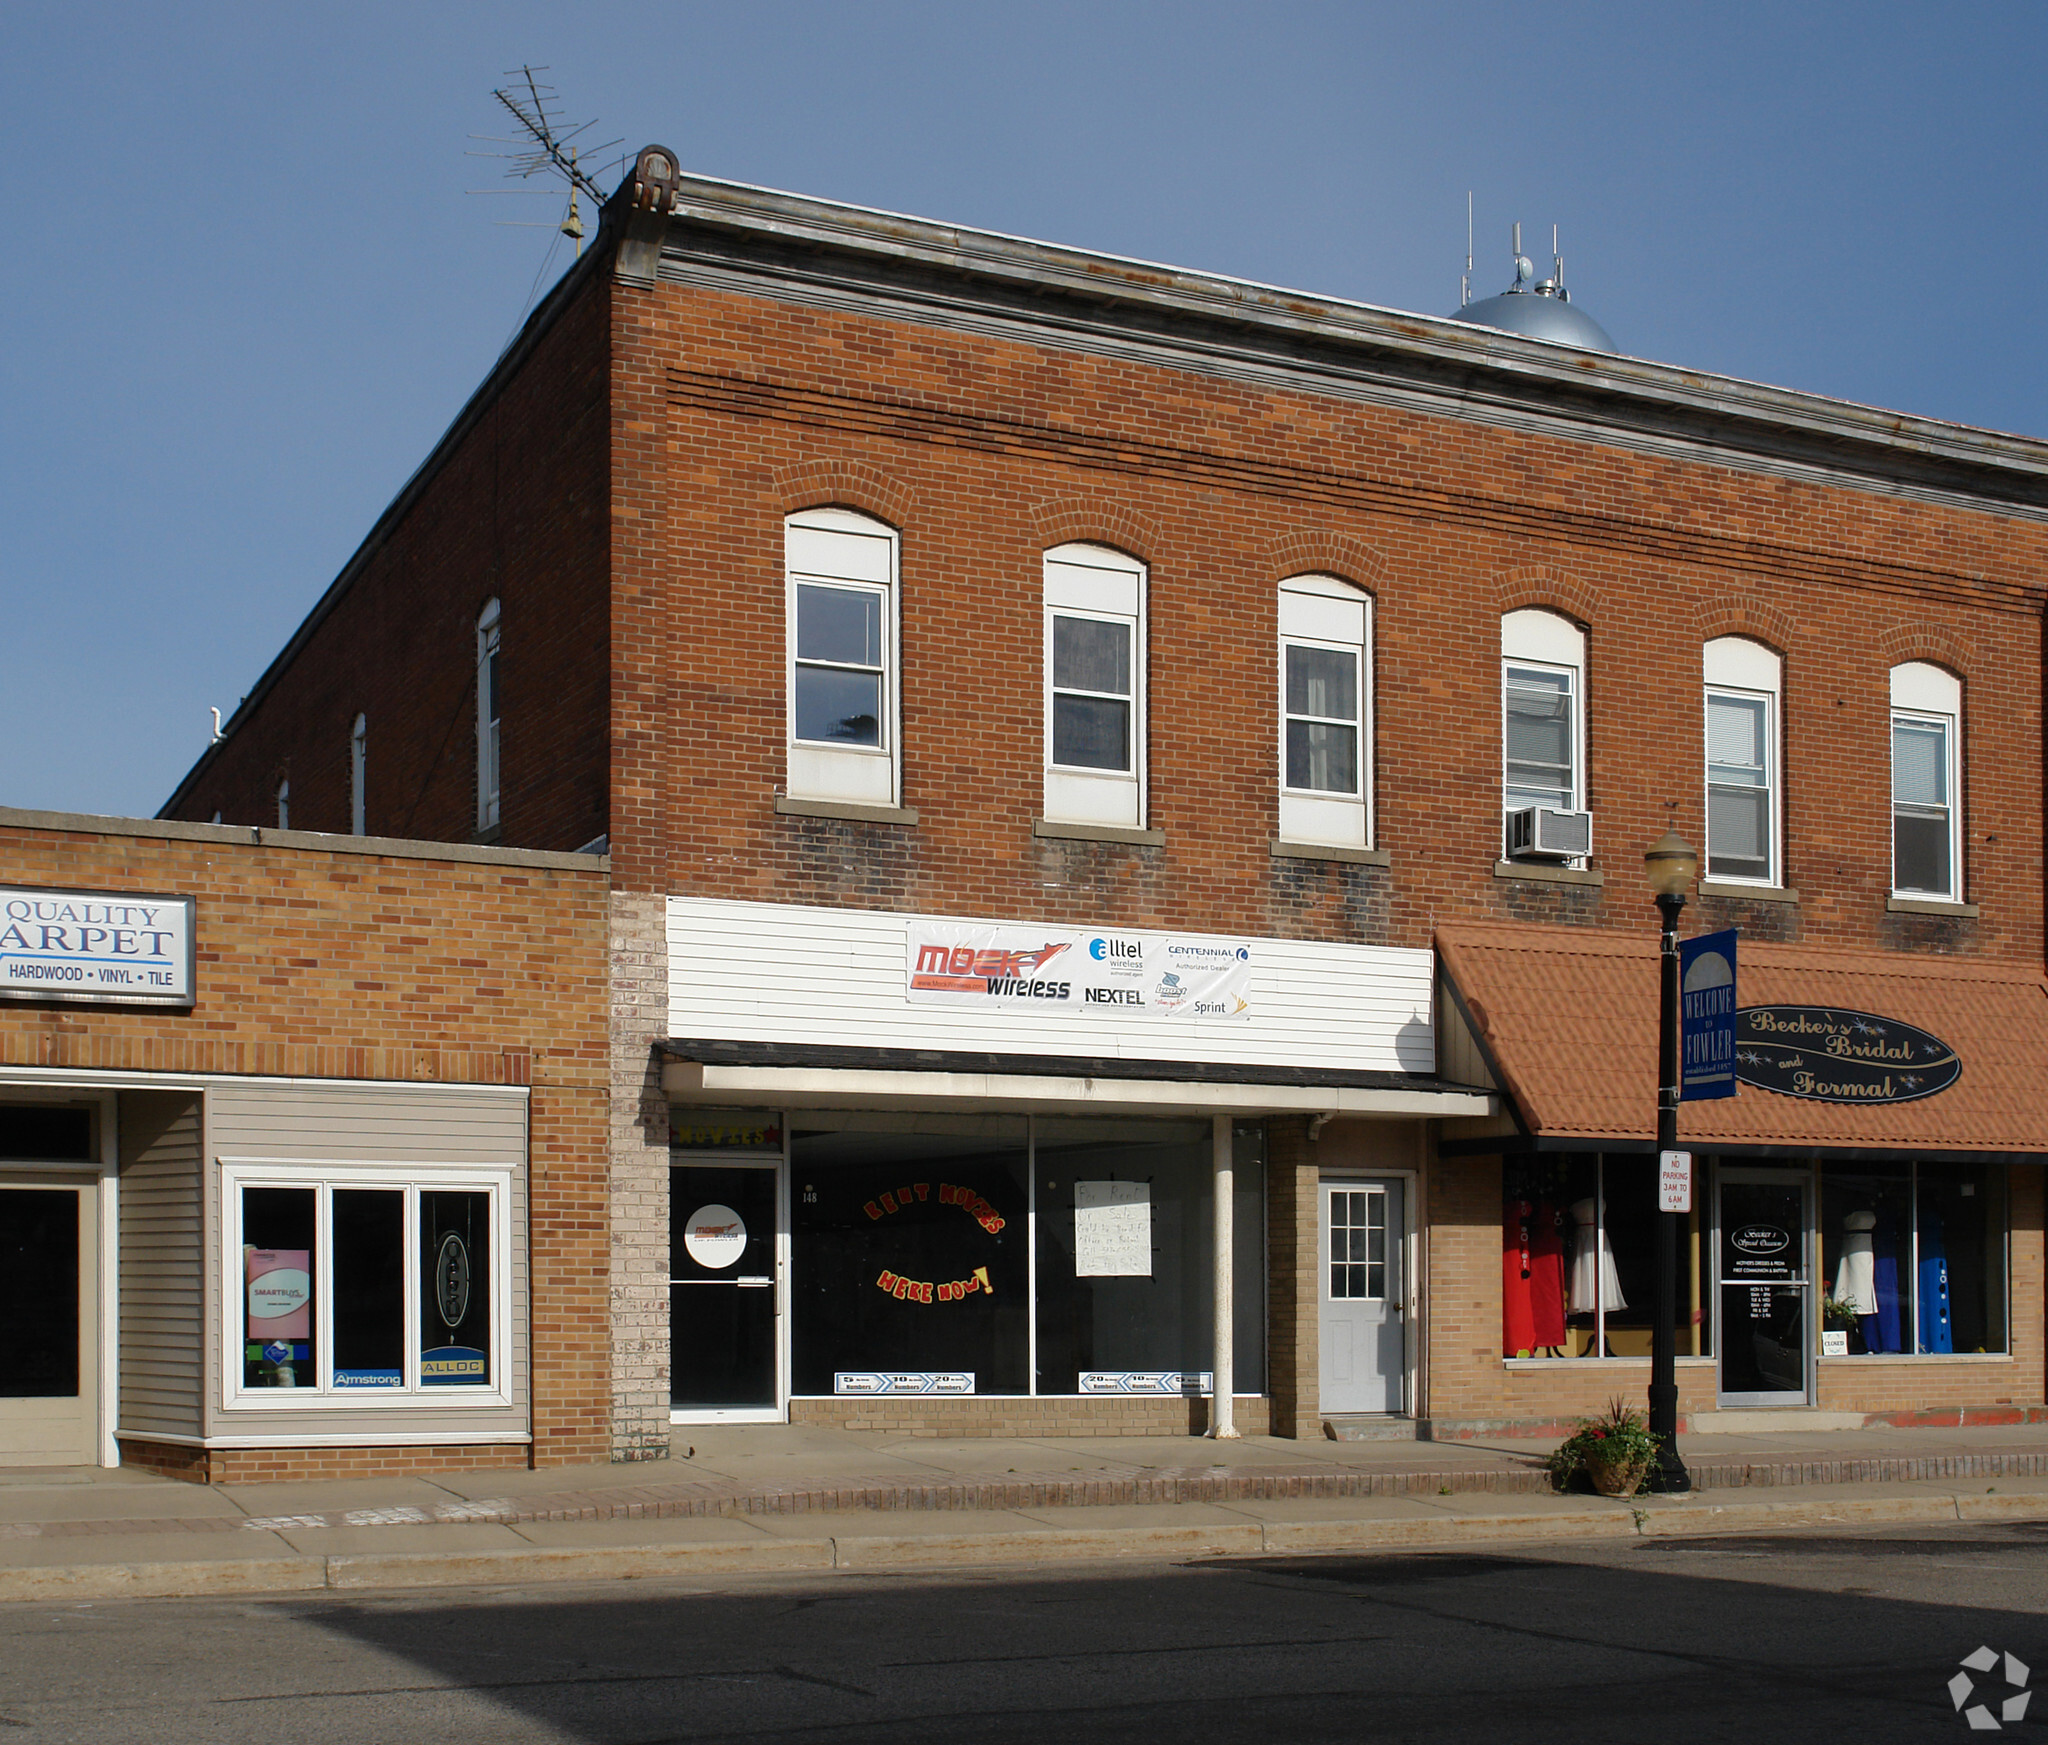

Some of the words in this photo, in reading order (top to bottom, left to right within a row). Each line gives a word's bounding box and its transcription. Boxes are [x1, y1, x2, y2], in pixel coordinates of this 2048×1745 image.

[6, 900, 160, 927] QUALITY
[1168, 945, 1234, 957] CENTENNIAL
[1110, 959, 1143, 969] wireless
[9, 964, 83, 981] HARDWOOD
[98, 968, 133, 984] VINYL
[148, 970, 173, 985] TILE
[1085, 988, 1145, 1005] NEXTEL
[1155, 984, 1187, 996] boost
[1194, 1001, 1226, 1014] Sprint
[1685, 987, 1732, 1019] WELCOME
[1686, 1029, 1732, 1065] FOWLER
[1825, 1034, 1914, 1061] Bridal
[1778, 1055, 1803, 1070] and
[1792, 1071, 1897, 1098] Formal
[680, 1125, 765, 1144] MOVIES
[1671, 1160, 1680, 1168] NO
[1662, 1171, 1688, 1181] PARKING
[1110, 1186, 1140, 1200] Rent
[1679, 1183, 1687, 1192] TO
[803, 1193, 817, 1203] 148
[1668, 1195, 1682, 1204] 6AM
[864, 1183, 930, 1220] RENT
[939, 1183, 1005, 1234] MOVIES
[1109, 1206, 1136, 1220] Sale
[877, 1270, 933, 1304] HERE
[424, 1361, 480, 1372] ALLOC
[334, 1371, 400, 1387] Armstrong
